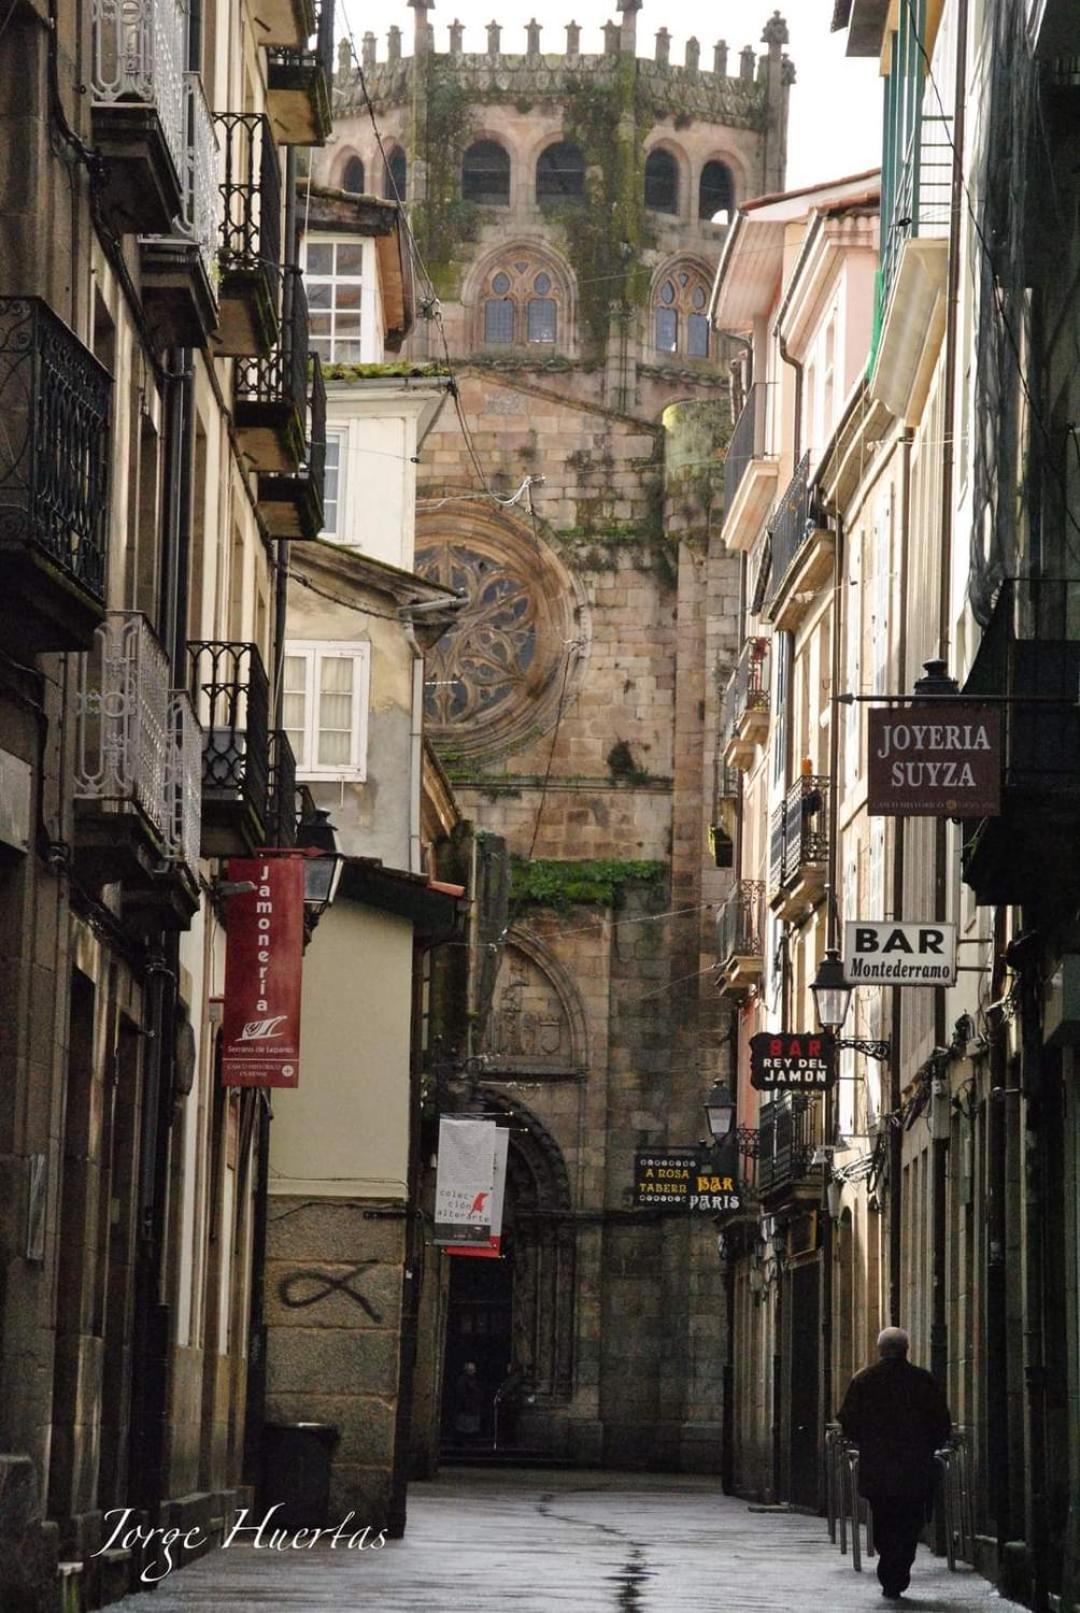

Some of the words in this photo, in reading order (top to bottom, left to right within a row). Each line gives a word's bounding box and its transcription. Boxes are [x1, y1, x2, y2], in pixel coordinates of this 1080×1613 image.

[877, 724, 991, 758] JOYERIA
[892, 762, 976, 787] SUYZA
[855, 928, 944, 954] BAR
[850, 958, 950, 979] Montederramo
[770, 1039, 821, 1057] BAR
[763, 1058, 792, 1068] REY
[799, 1059, 828, 1069] DEL
[764, 1070, 827, 1082] JAMON
[646, 1169, 654, 1178] A
[658, 1169, 690, 1179] ROSA
[696, 1177, 734, 1193] BAR
[689, 1195, 740, 1211] PARIS
